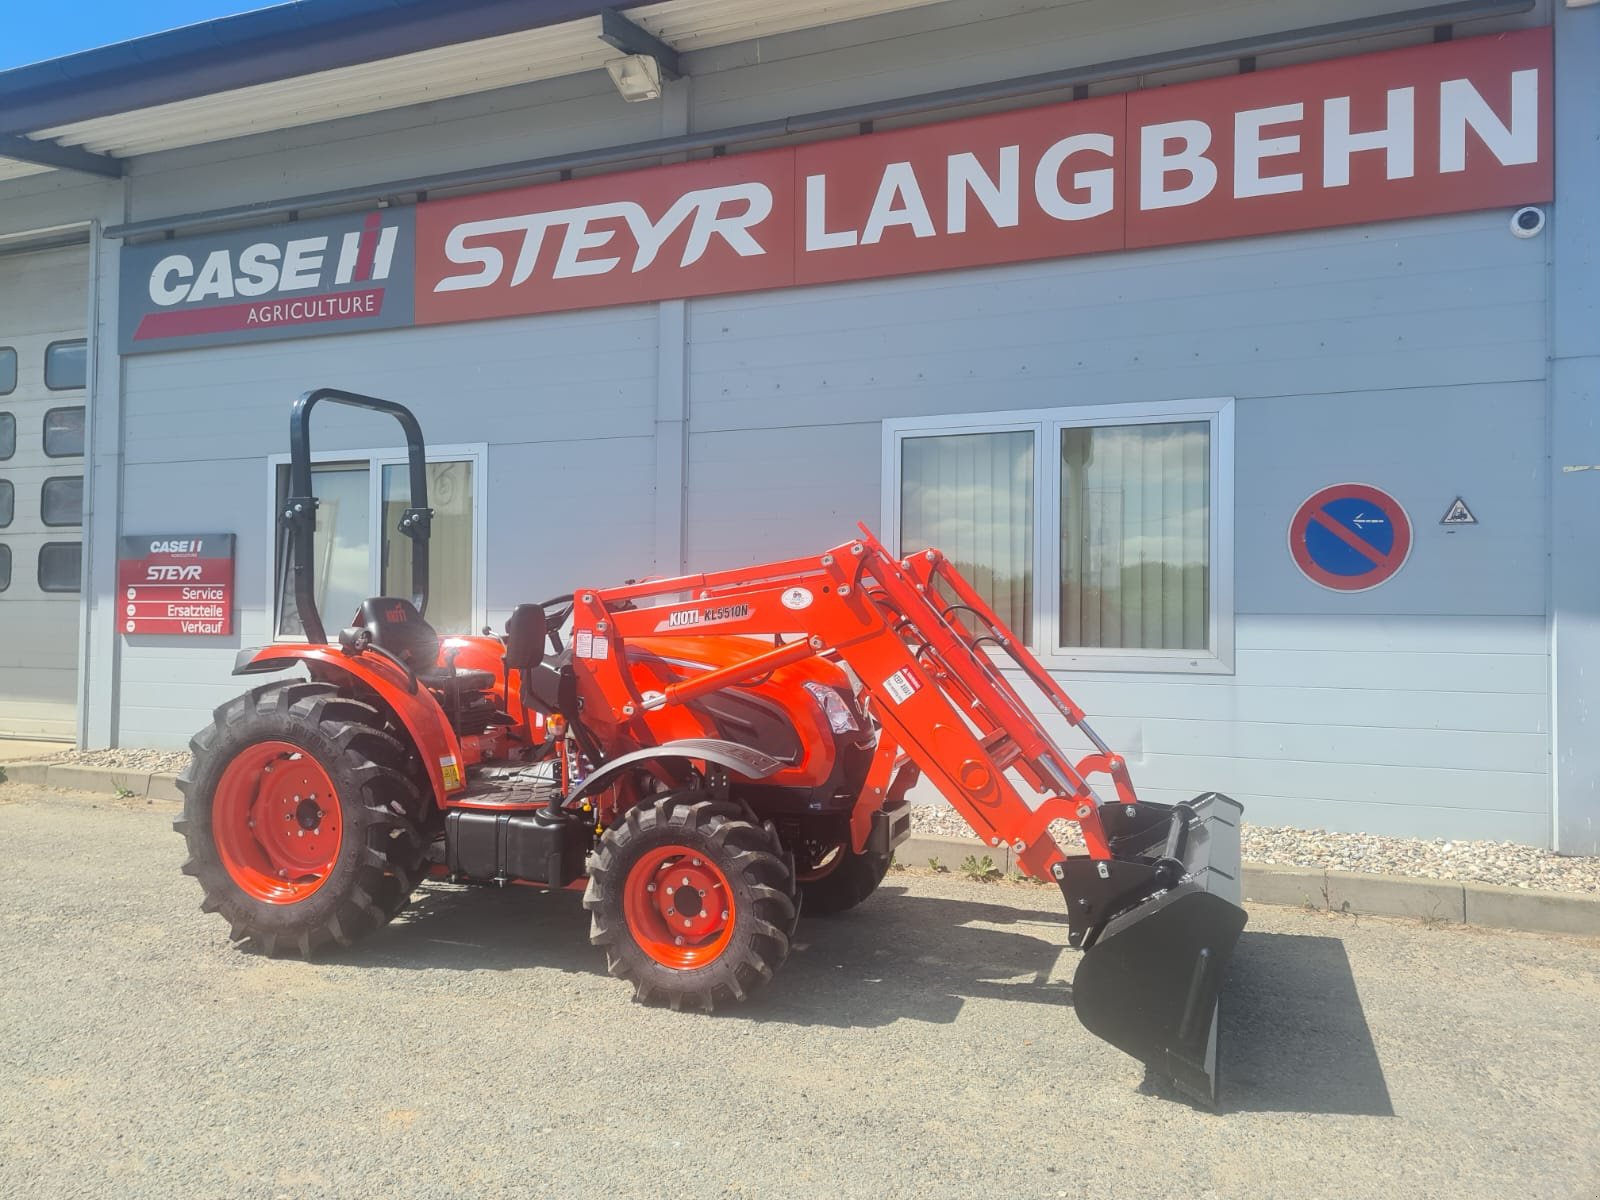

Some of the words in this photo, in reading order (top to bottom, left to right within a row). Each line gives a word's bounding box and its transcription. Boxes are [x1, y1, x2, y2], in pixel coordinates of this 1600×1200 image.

[805, 68, 1538, 252] LANGBEHN
[433, 182, 773, 292] STEYR
[149, 236, 328, 306] CASE
[247, 294, 375, 324] AGRICULTURE
[150, 540, 188, 553] CASE
[145, 565, 203, 580] STEYR
[182, 587, 224, 600] Service
[167, 604, 223, 617] Ersatzteile
[669, 609, 699, 627] KIOTI
[704, 604, 749, 622] KL5510N
[181, 620, 223, 633] Verkauf
